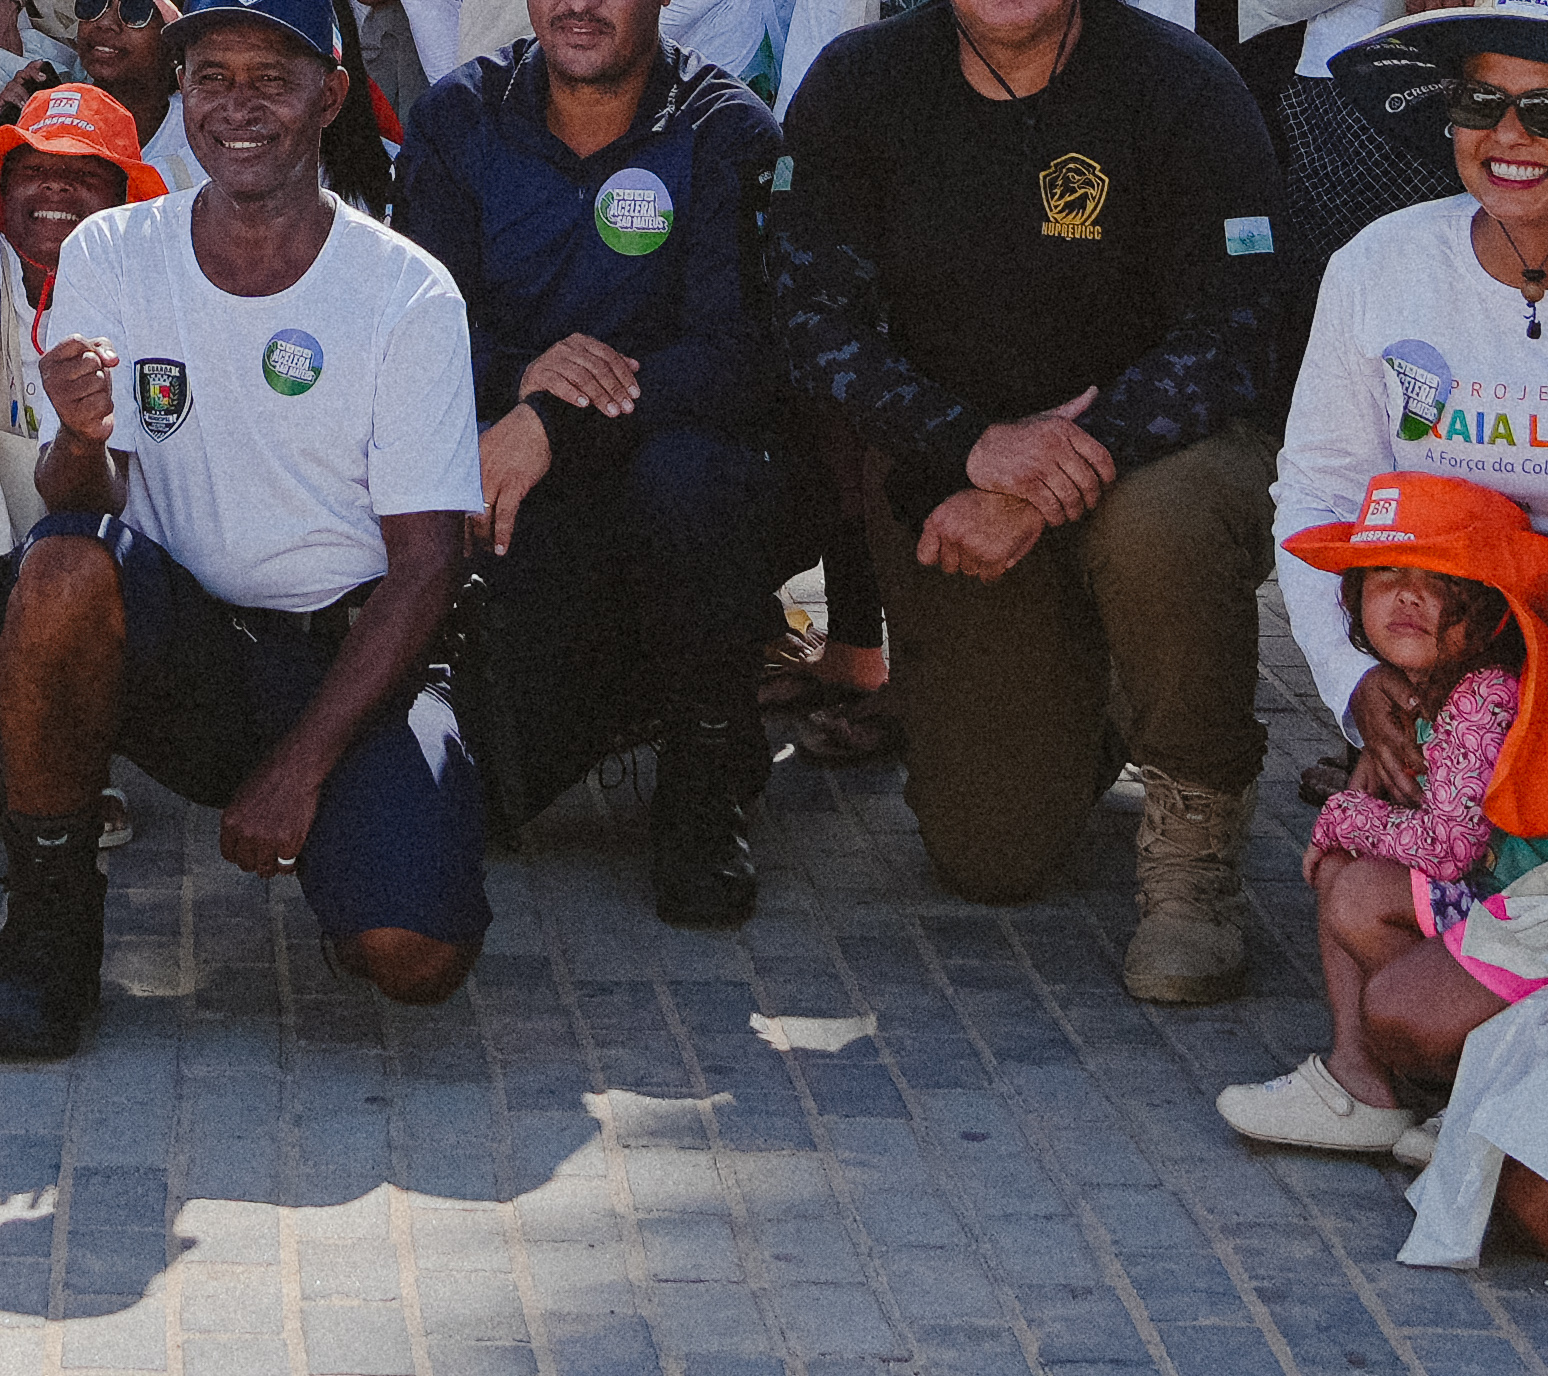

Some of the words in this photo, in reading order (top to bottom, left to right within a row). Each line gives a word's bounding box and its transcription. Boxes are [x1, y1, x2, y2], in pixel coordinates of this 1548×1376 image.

[610, 199, 656, 218] ACELERA
[1440, 451, 1484, 472] Força
[1491, 457, 1514, 473] da
